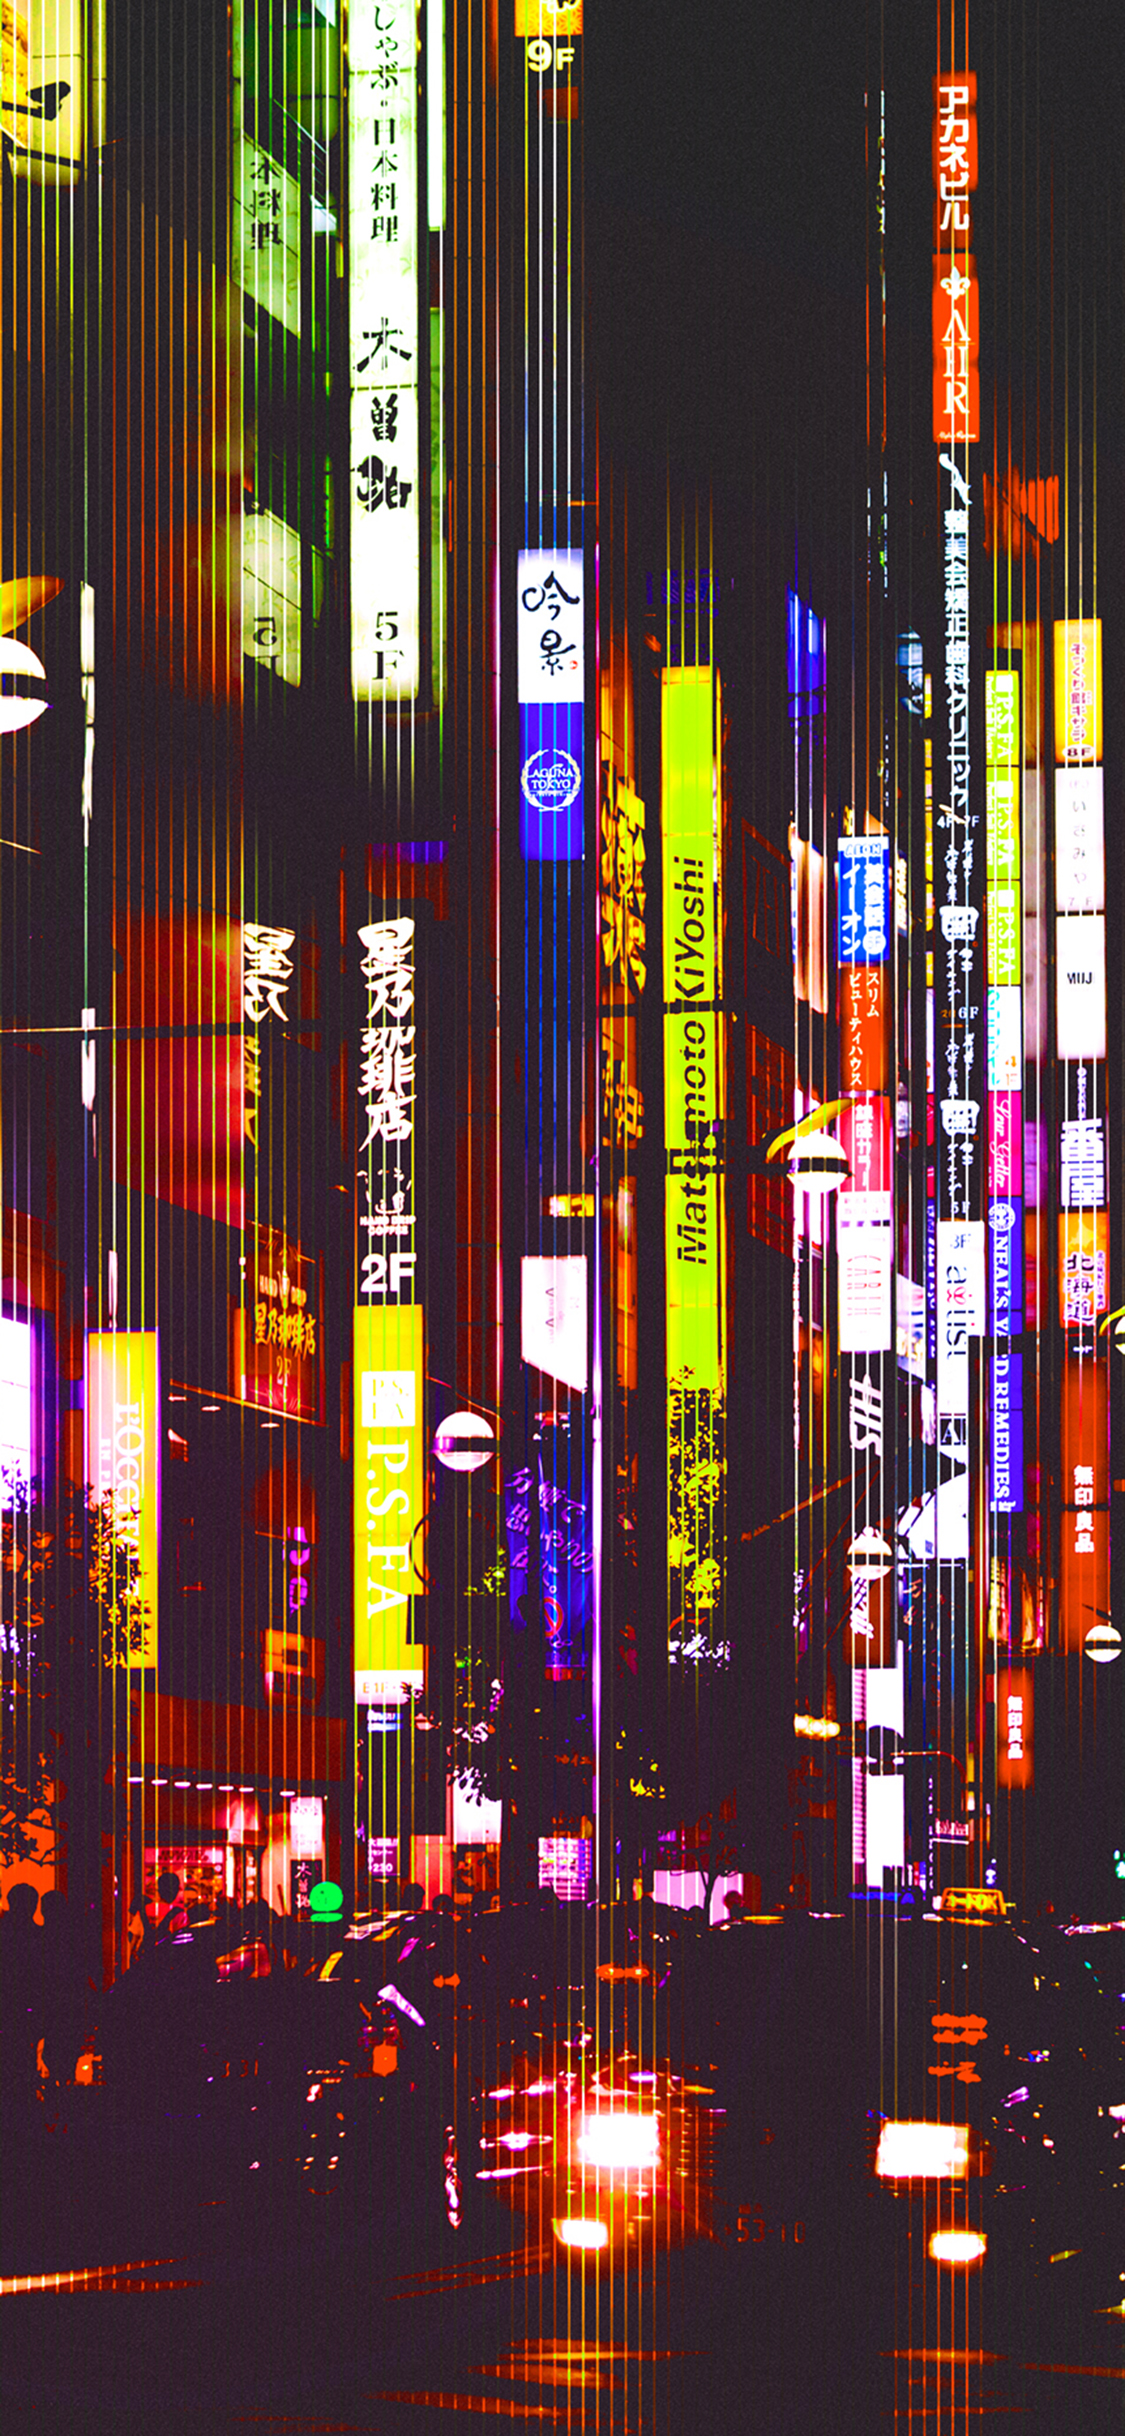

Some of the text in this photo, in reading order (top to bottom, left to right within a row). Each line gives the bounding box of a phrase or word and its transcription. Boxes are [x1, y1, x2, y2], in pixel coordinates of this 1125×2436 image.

[527, 39, 575, 72] 9F
[939, 86, 969, 230] アカネビル
[374, 611, 405, 681] 5F
[529, 763, 573, 778] LAGUNA
[531, 779, 571, 790] TOKYO
[842, 864, 861, 955] イーオン
[866, 972, 880, 1018] スリム
[1067, 971, 1095, 985] MUJ
[849, 973, 862, 1086] ビューティハウス
[677, 1020, 708, 1265] Matmoto
[360, 1252, 417, 1292] 2F
[993, 1234, 1011, 1309] NEAL'S
[993, 1316, 1011, 1377] YAD
[993, 1381, 1011, 1500] REMEDIES
[366, 1439, 410, 1620] P.S.FA
[1073, 1464, 1095, 1554] 無印良品
